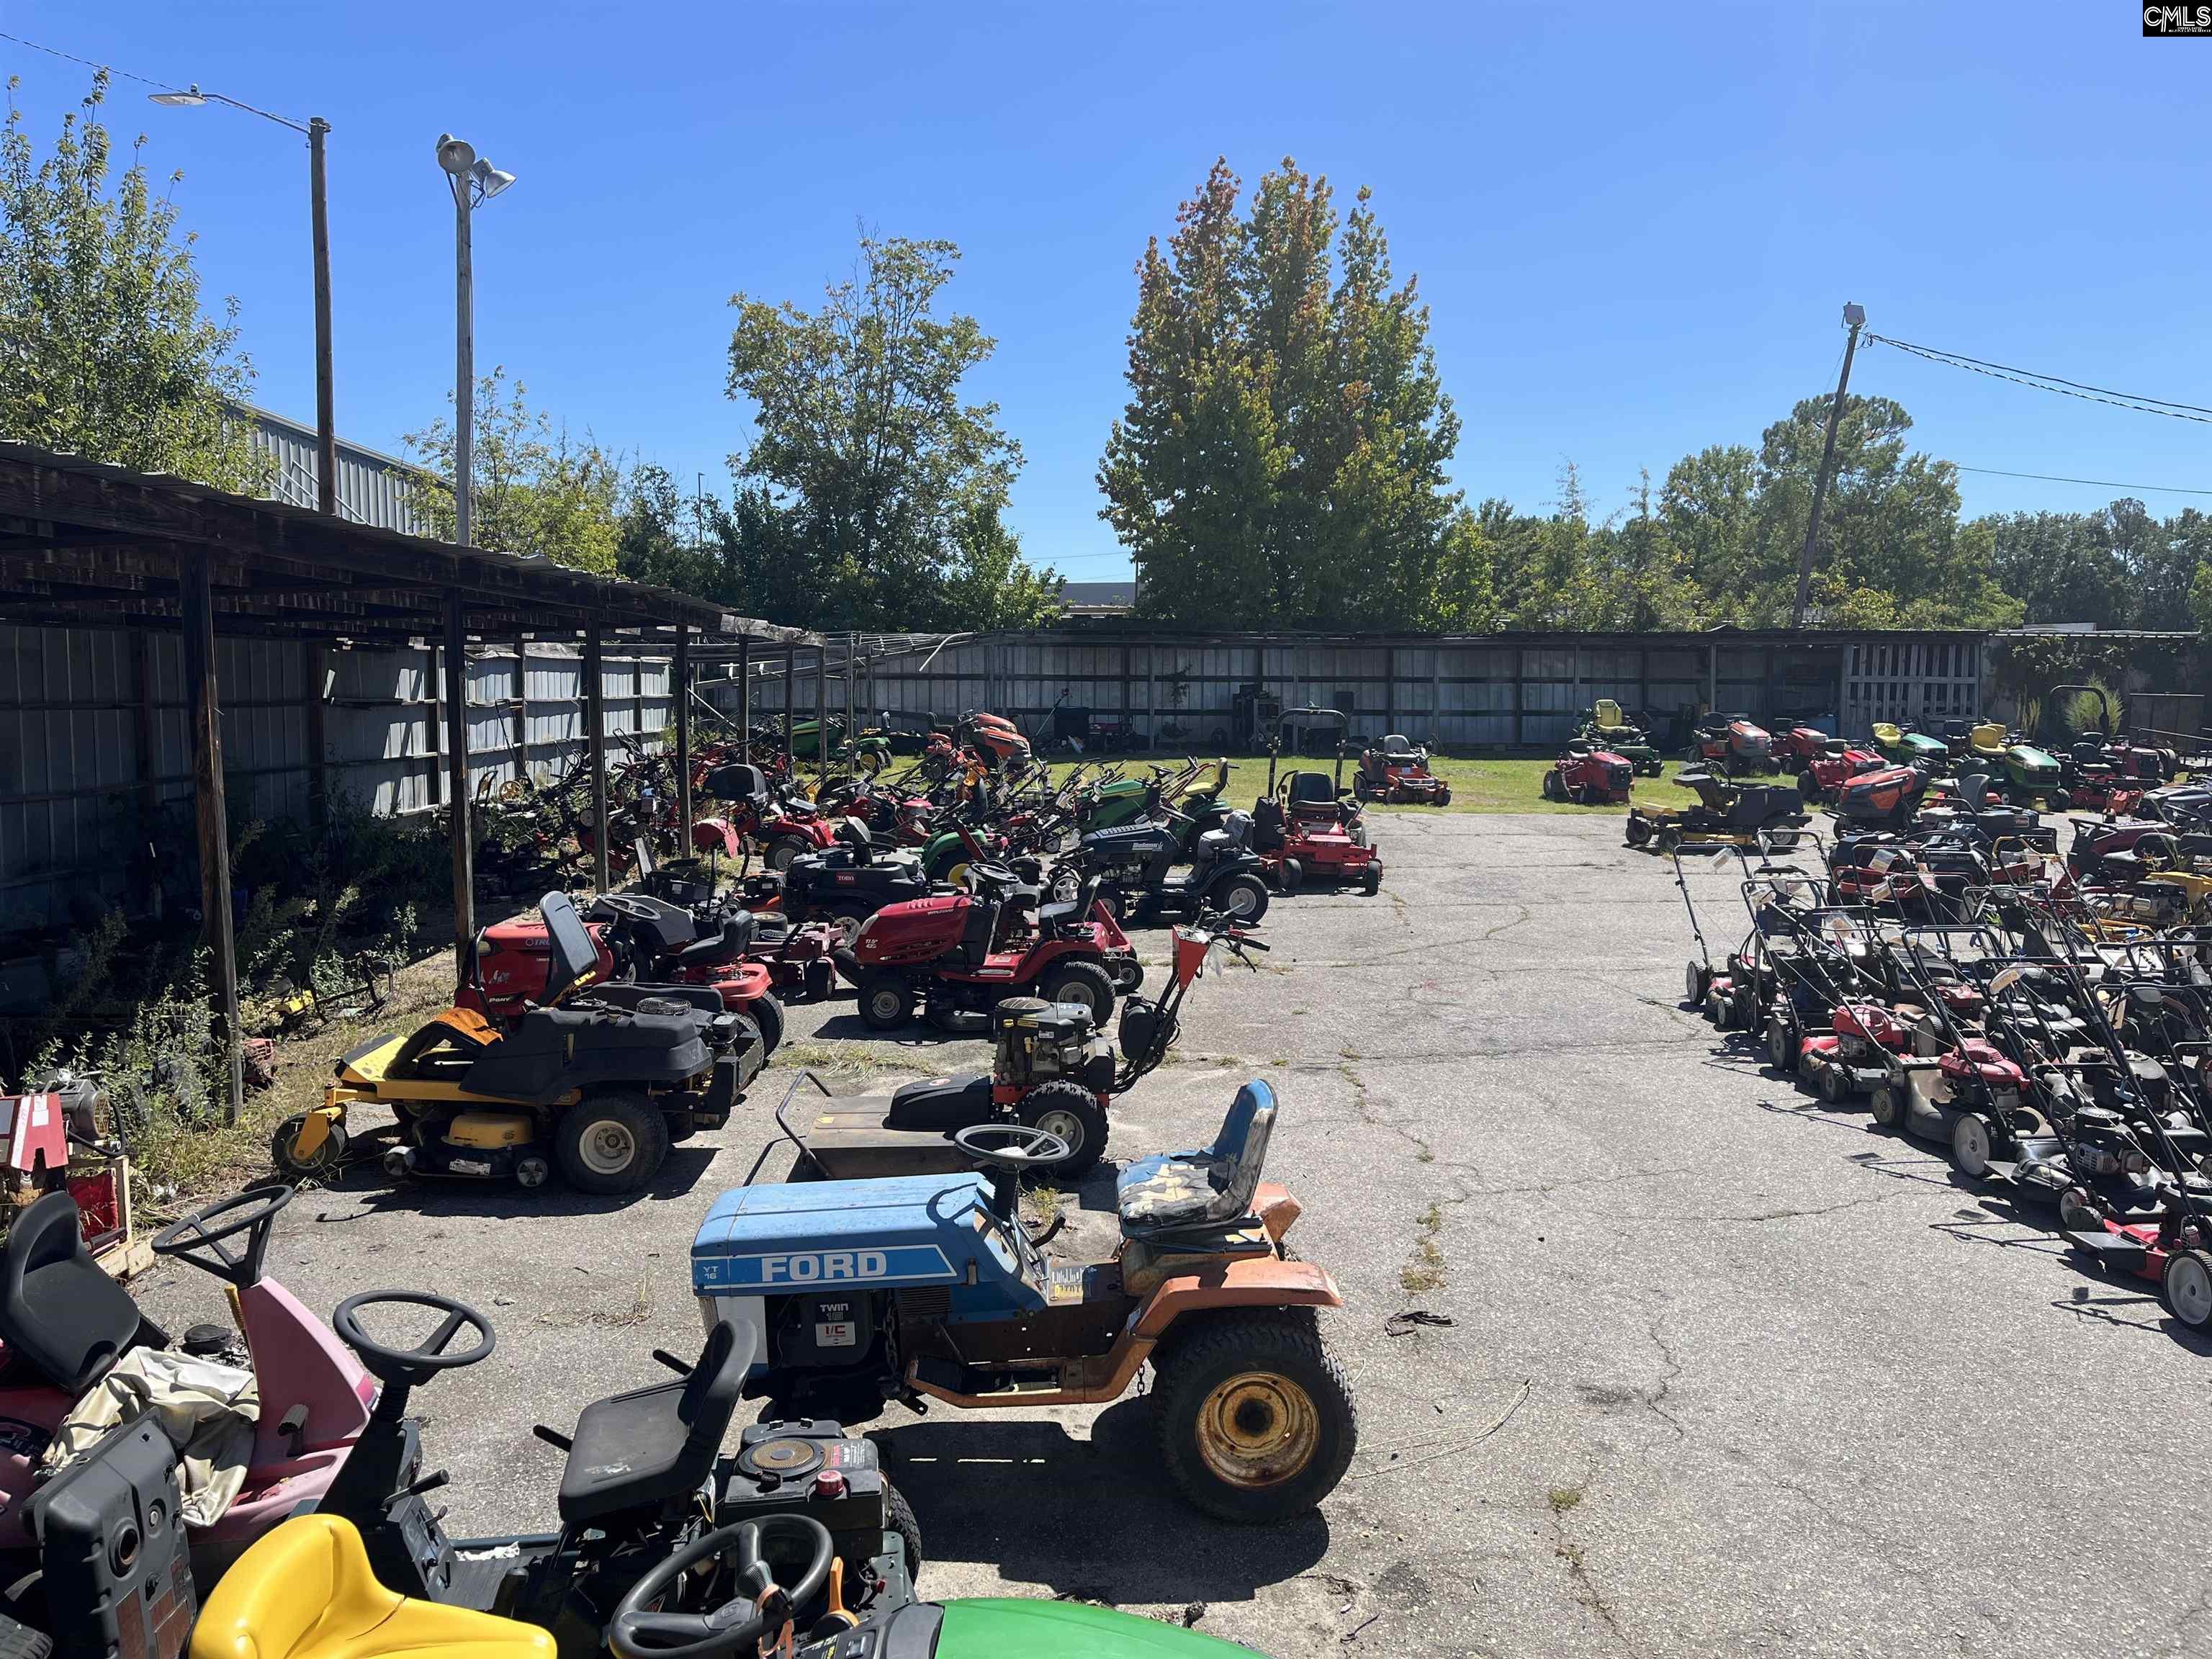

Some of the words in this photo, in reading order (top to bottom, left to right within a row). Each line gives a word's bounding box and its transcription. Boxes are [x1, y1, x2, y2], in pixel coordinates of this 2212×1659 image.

[761, 1251, 887, 1282] FORD
[819, 1303, 849, 1313] TWIN
[824, 1324, 846, 1335] I/C
